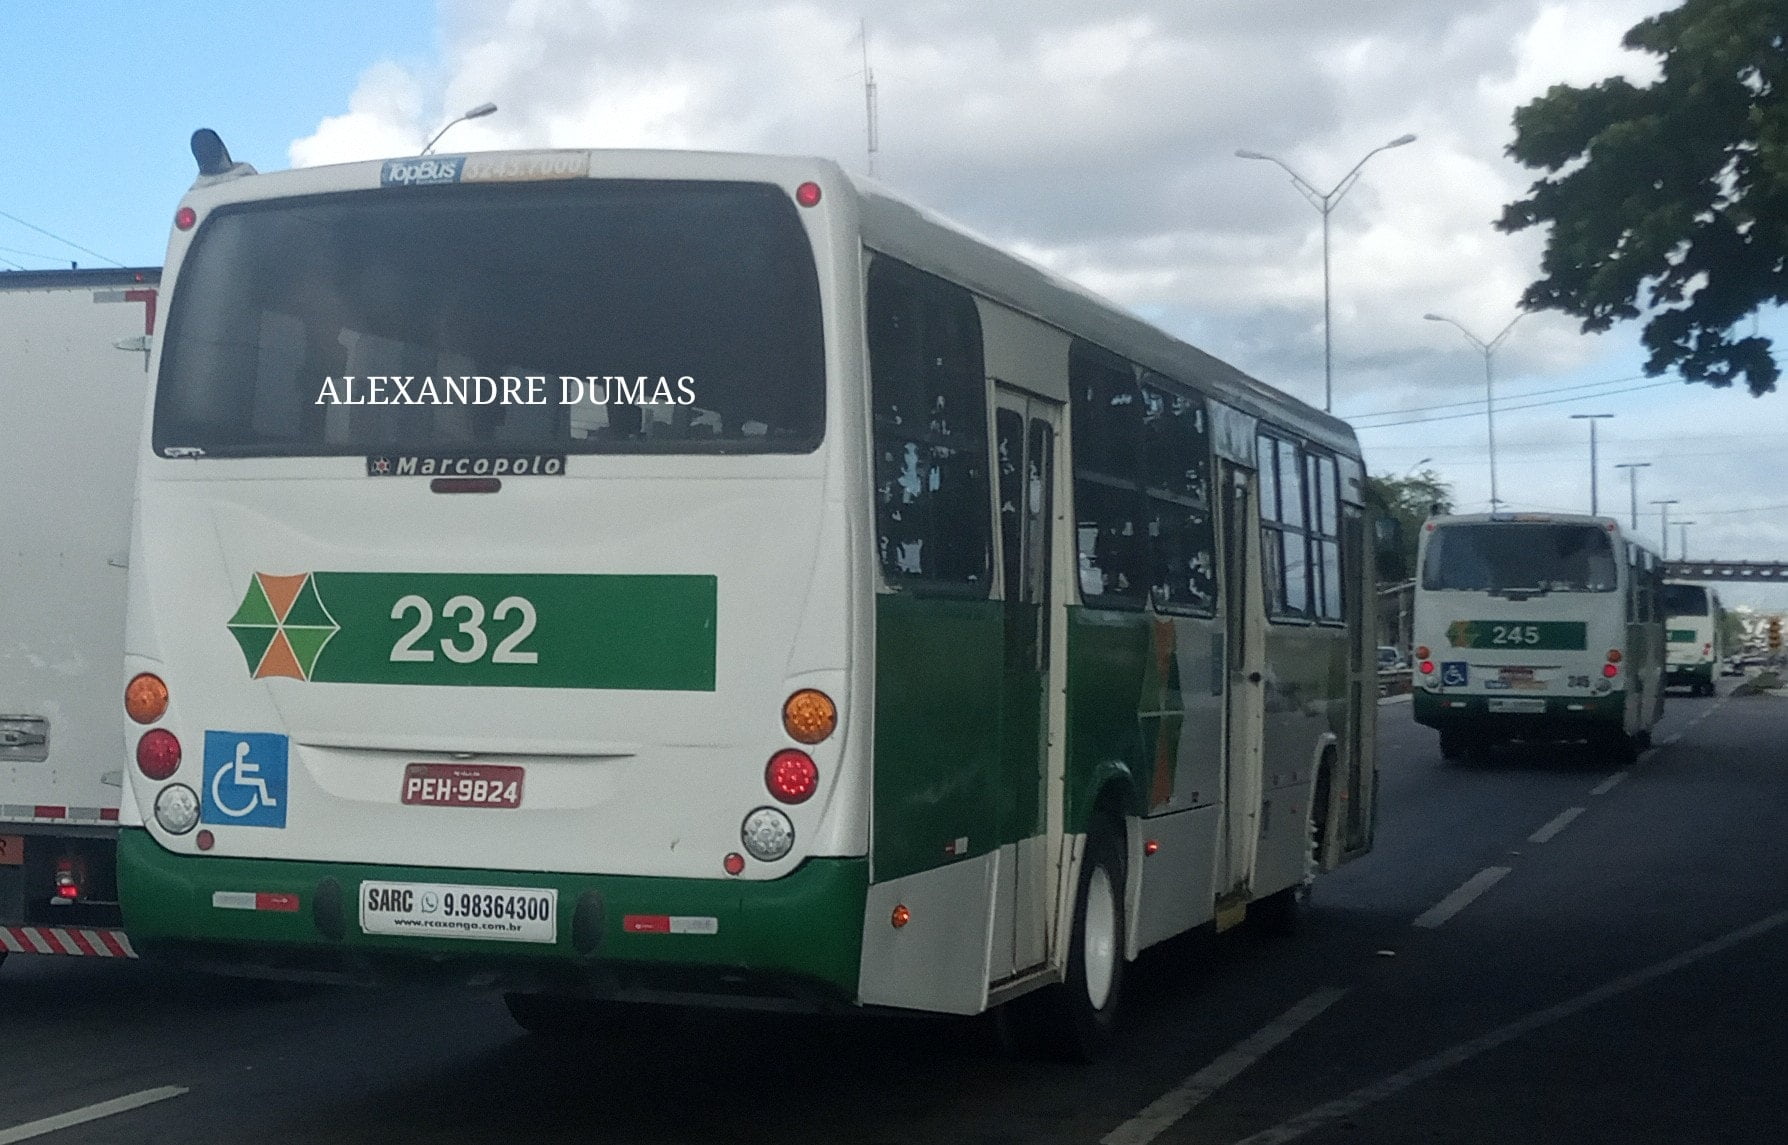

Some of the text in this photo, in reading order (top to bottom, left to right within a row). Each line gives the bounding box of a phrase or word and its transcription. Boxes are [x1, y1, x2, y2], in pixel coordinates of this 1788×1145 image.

[389, 160, 456, 185] TopBus
[396, 456, 562, 476] Marcopolo
[389, 594, 538, 664] 232
[1492, 626, 1540, 645] 245
[368, 888, 549, 921] SARC 9.98364300
